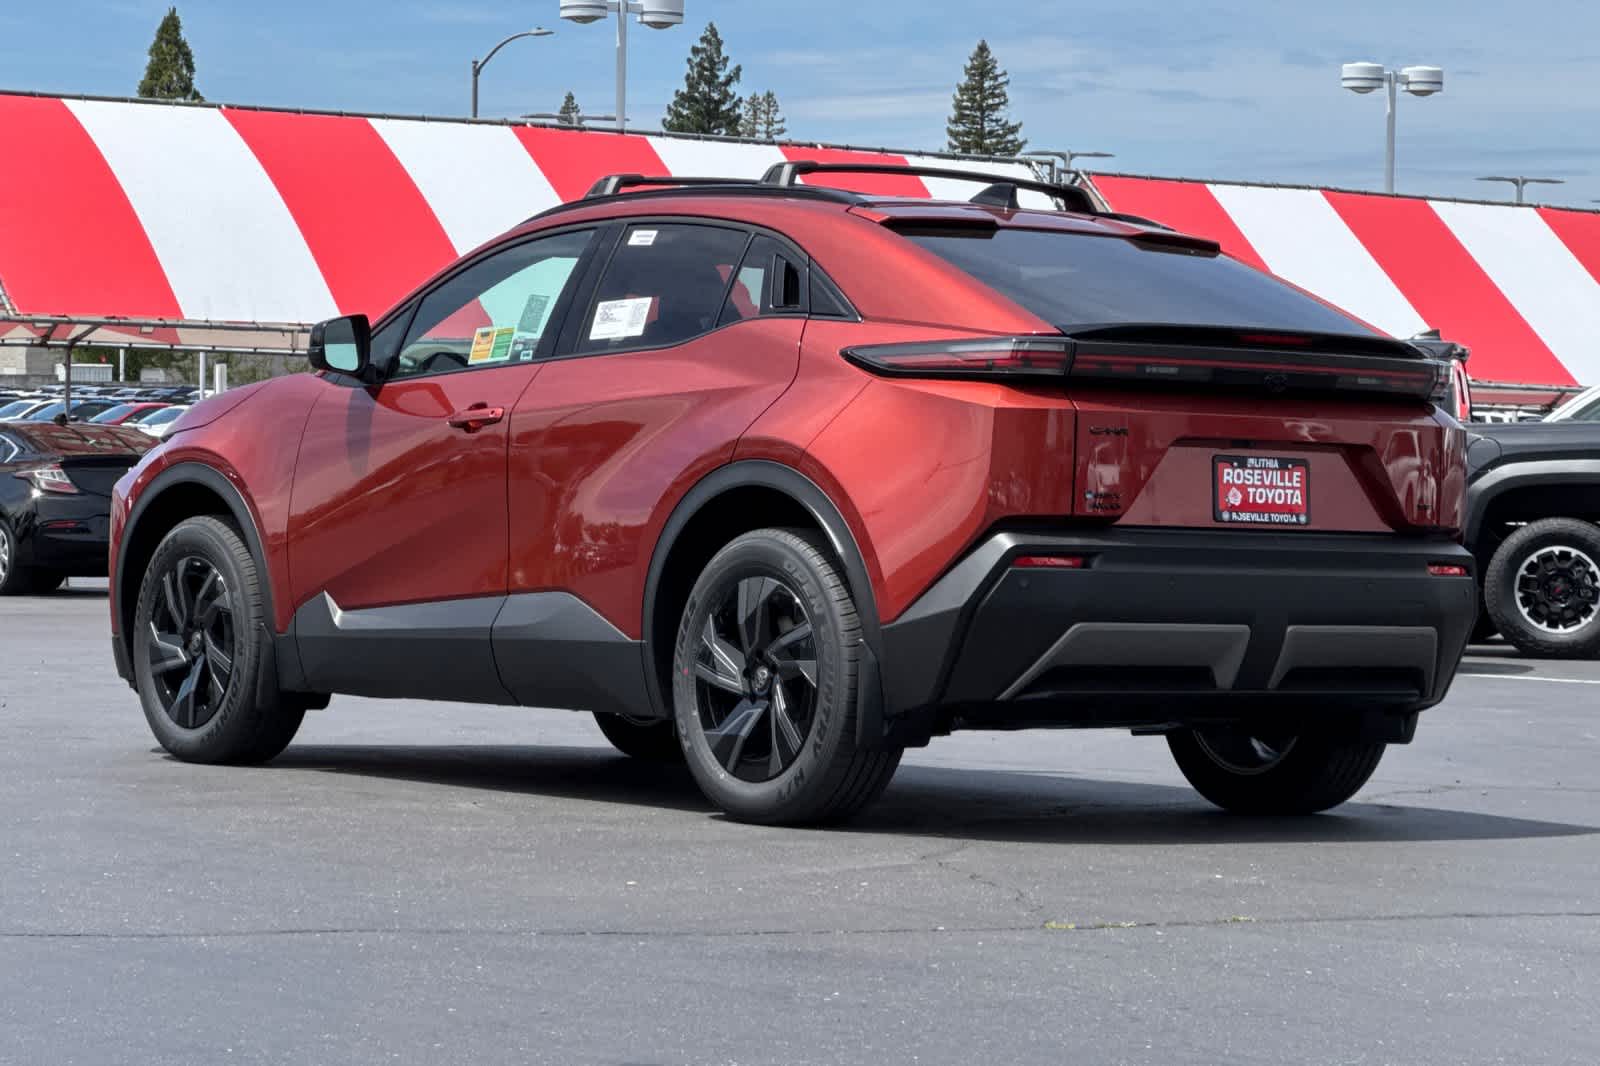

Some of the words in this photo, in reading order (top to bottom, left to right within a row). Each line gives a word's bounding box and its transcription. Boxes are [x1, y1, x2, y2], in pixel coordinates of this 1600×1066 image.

[1253, 458, 1279, 469] LITHIA
[1223, 468, 1301, 487] ROSEVILLE
[1247, 487, 1302, 505] TOYOTA
